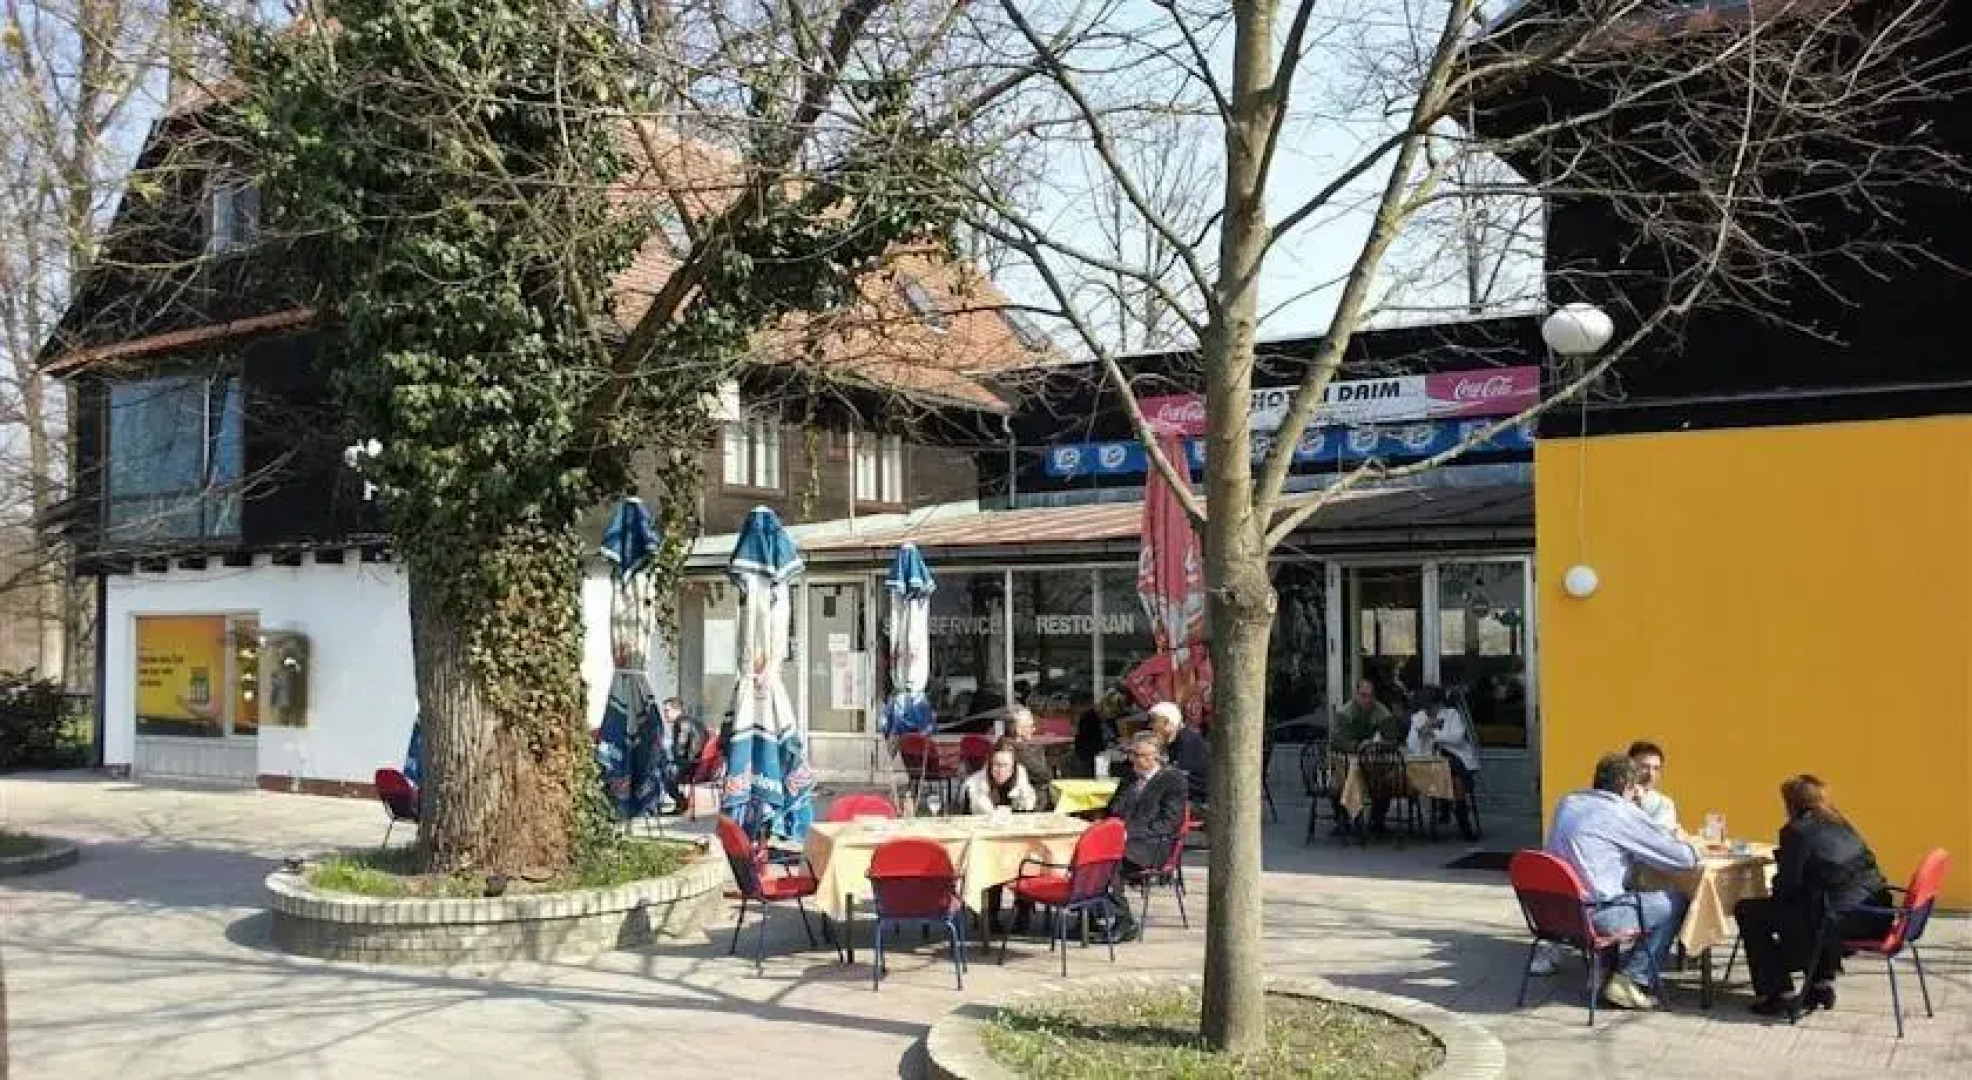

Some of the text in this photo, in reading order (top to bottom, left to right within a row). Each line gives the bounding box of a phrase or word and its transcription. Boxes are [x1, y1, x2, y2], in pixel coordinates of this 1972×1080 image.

[1453, 376, 1513, 400] Coca-Cola
[929, 613, 1135, 635] SERVICE RESTORAN
